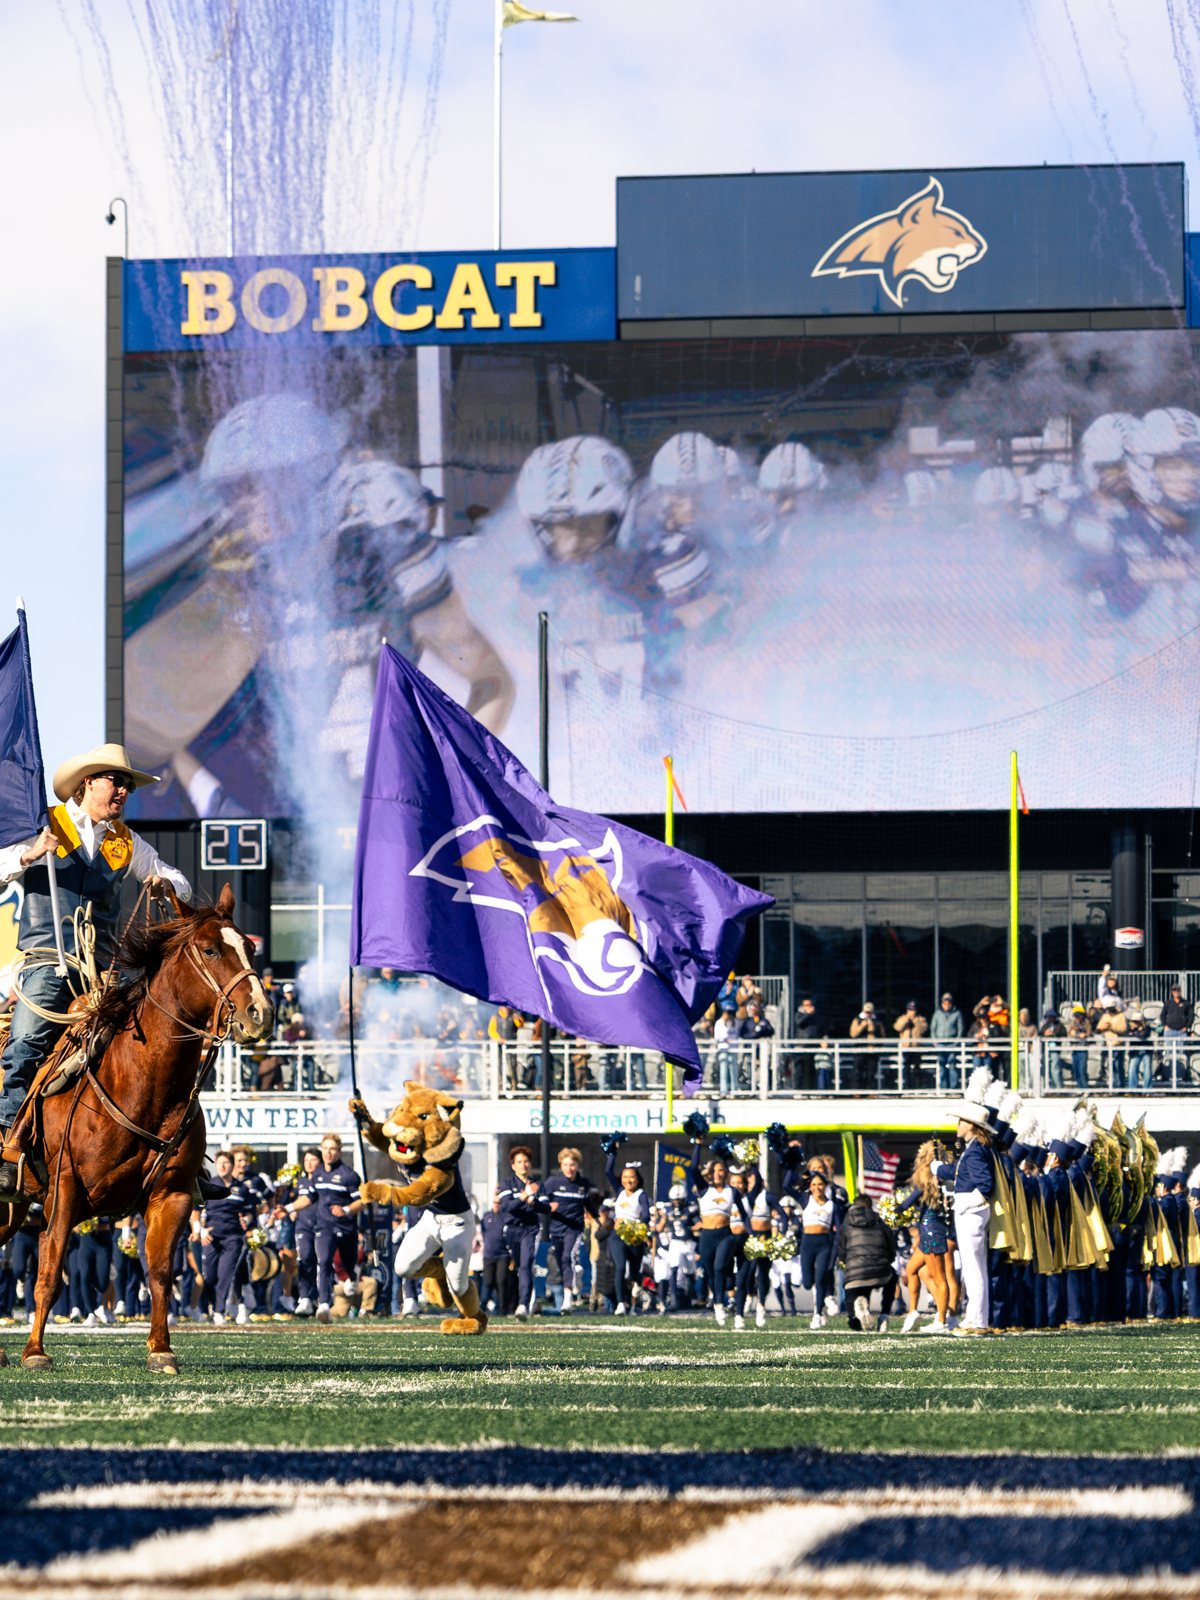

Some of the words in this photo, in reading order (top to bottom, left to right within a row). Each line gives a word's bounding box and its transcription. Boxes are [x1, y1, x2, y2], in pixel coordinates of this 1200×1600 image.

[181, 261, 555, 336] BOBCAT
[207, 825, 260, 864] 25
[205, 1107, 255, 1128] WN
[530, 1107, 638, 1128] Bozeman
